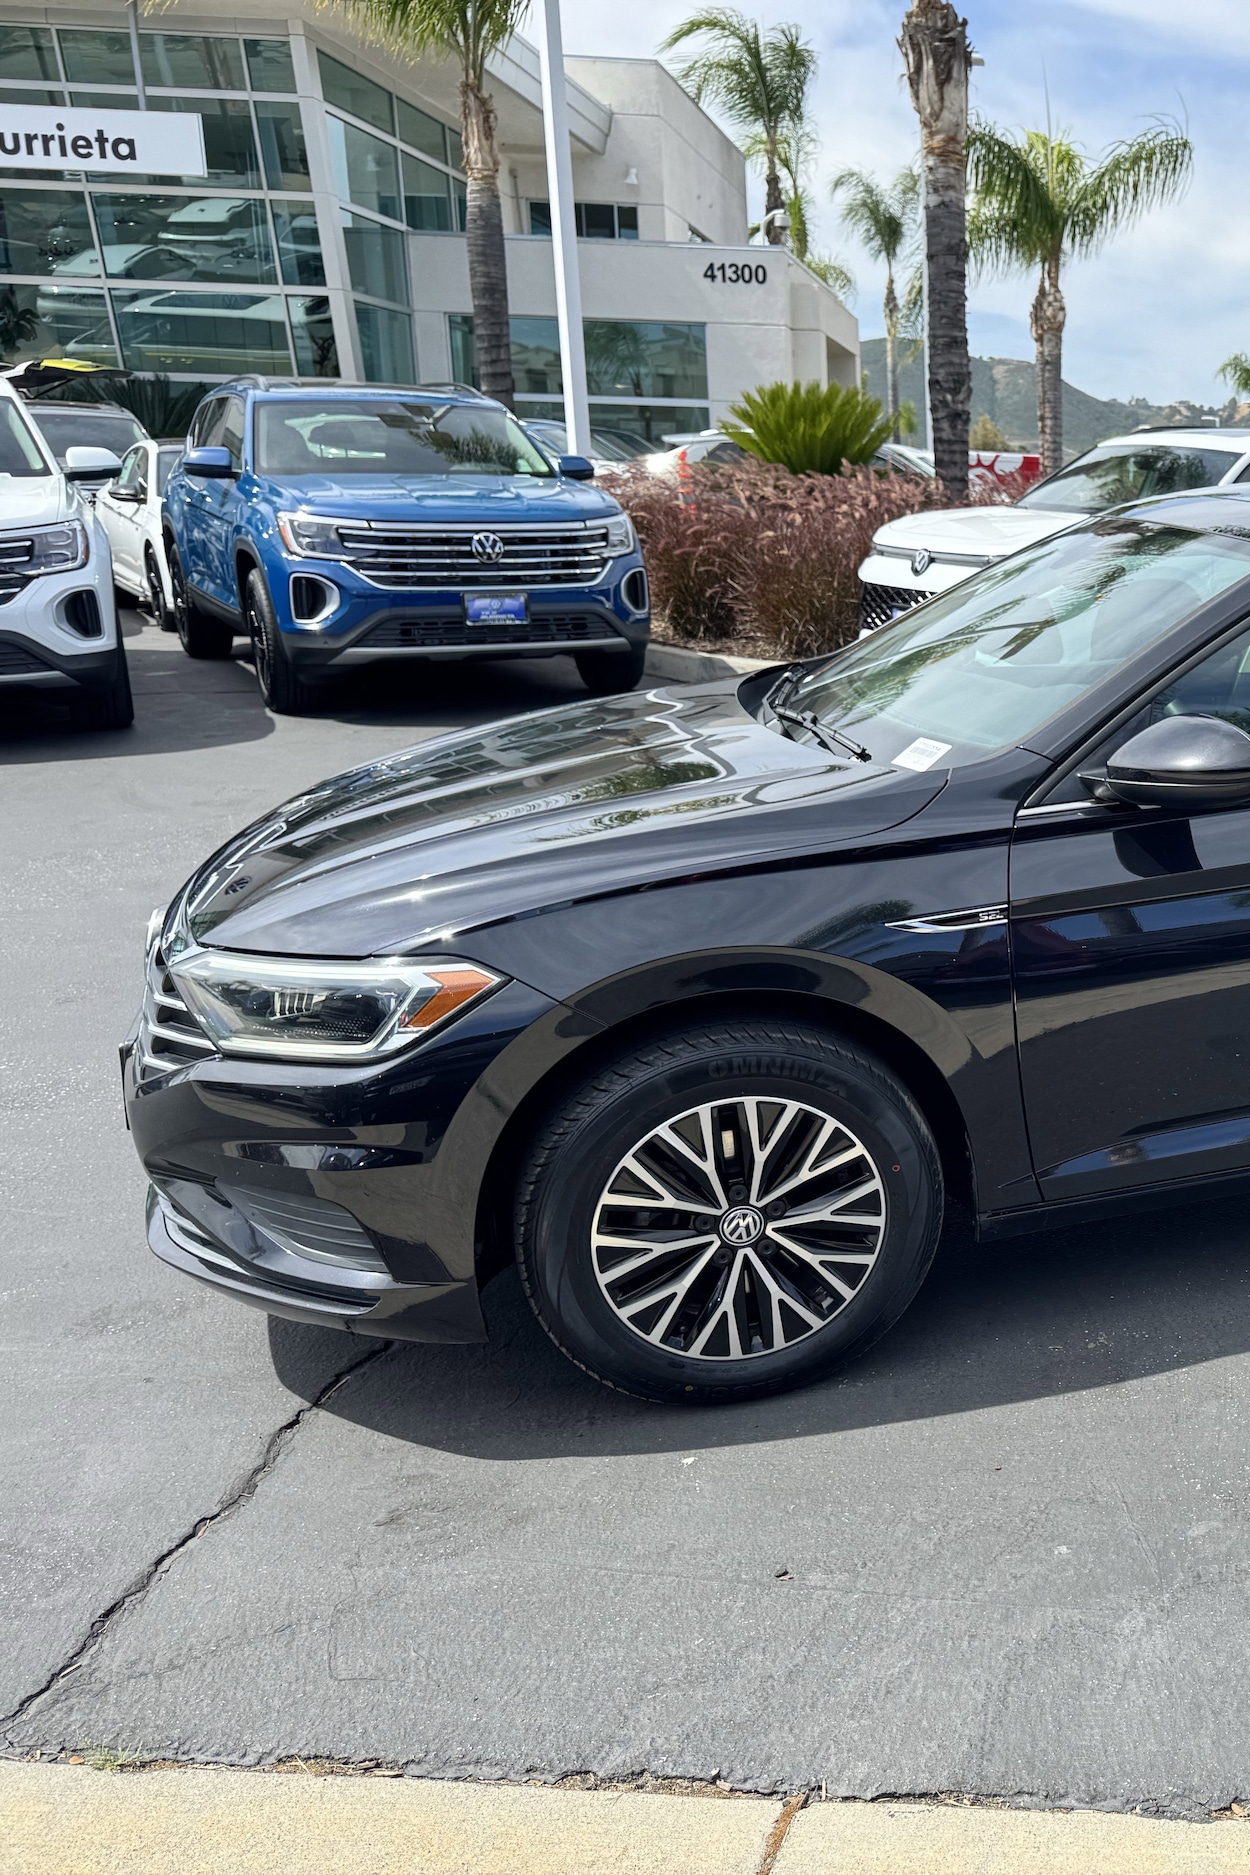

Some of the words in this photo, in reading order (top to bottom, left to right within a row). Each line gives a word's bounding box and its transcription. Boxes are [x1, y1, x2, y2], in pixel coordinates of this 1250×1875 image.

[0, 122, 137, 161] urrieta
[703, 262, 767, 284] 41300
[978, 910, 1004, 921] SEL
